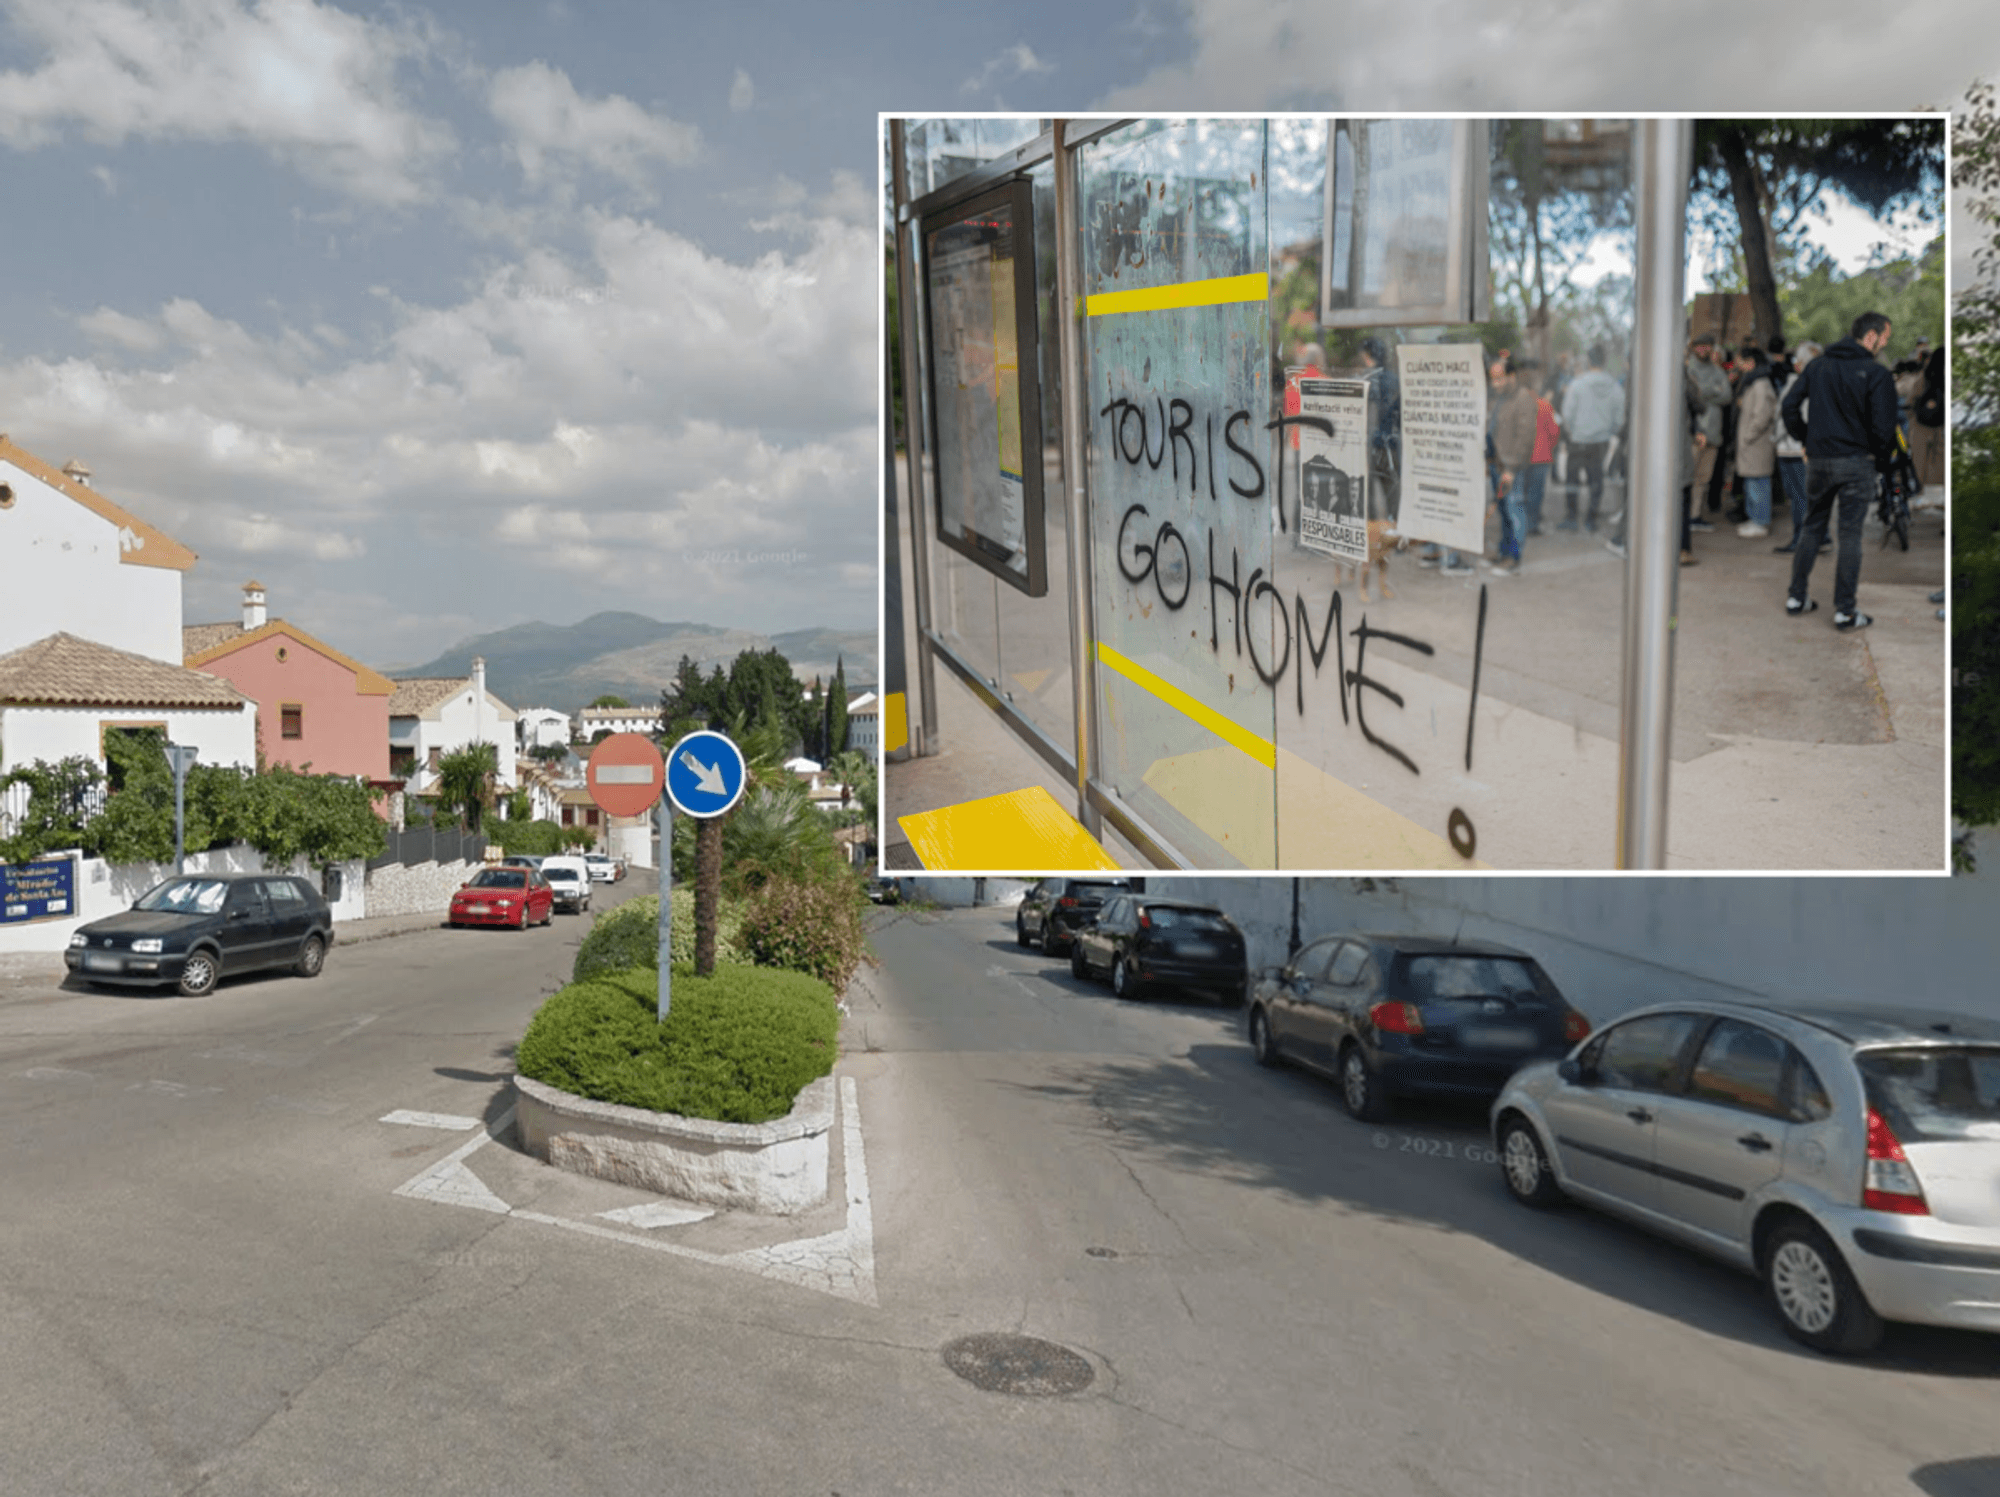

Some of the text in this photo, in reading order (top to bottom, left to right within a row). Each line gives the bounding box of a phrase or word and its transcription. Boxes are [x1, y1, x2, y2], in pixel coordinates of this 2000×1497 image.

[1101, 397, 1336, 533] TOURIST
[1117, 503, 1191, 610] GO
[1302, 517, 1366, 548] RESPONSABLES
